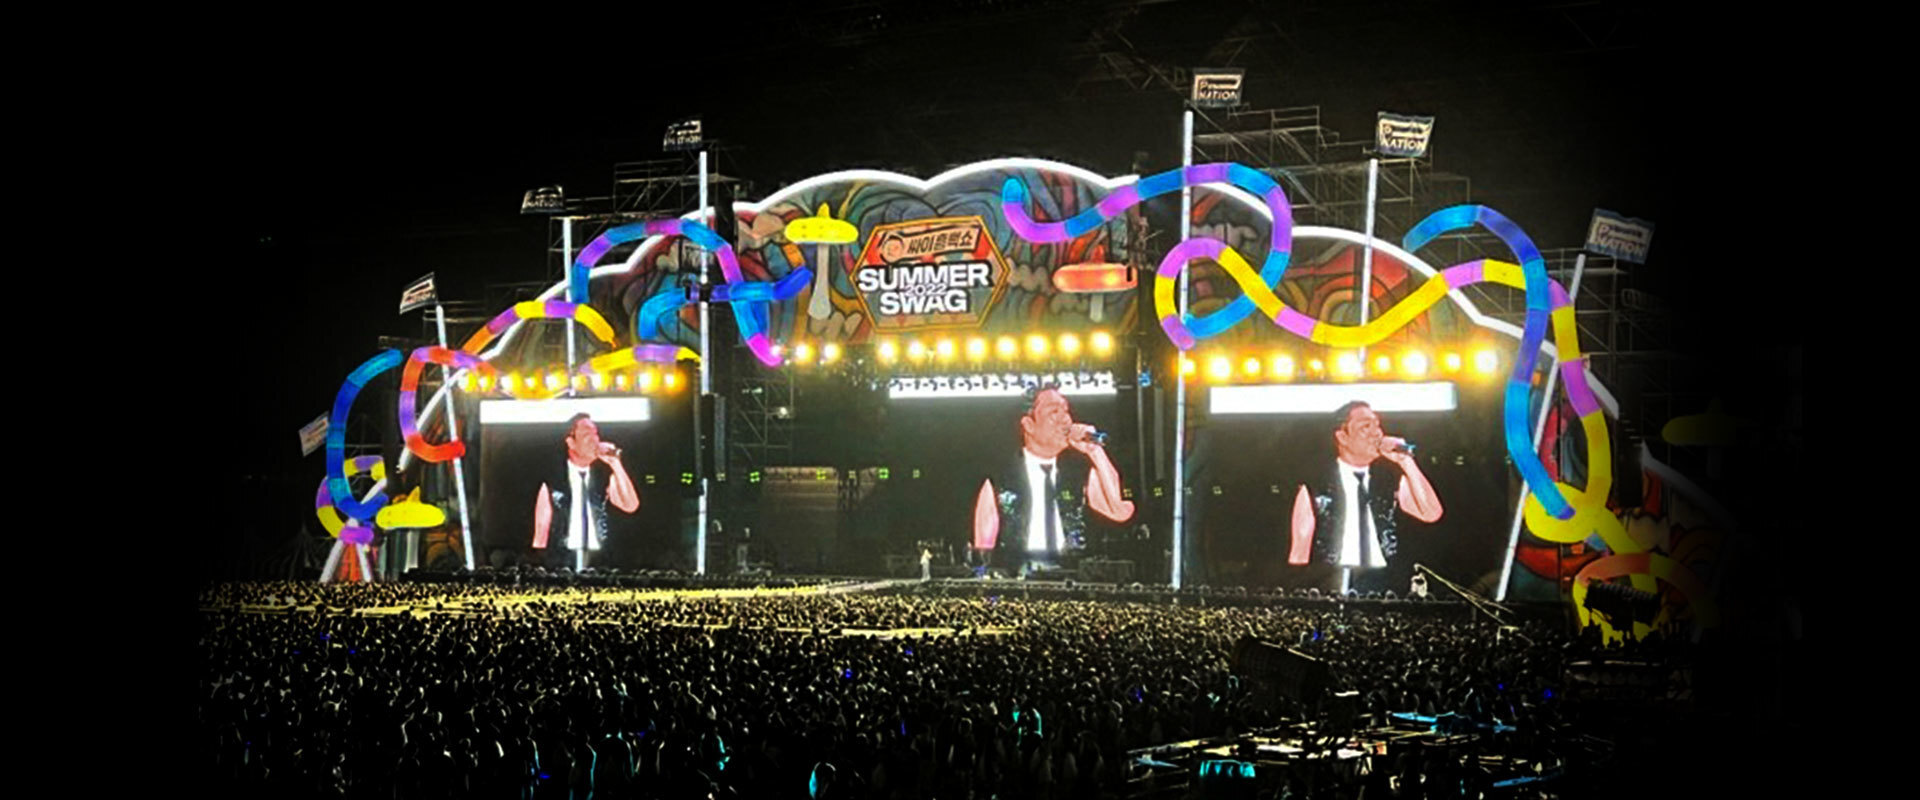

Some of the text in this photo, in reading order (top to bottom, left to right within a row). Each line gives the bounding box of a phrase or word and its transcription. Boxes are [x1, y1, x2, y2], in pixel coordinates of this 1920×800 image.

[1199, 90, 1238, 100] NATION
[1381, 137, 1426, 151] NATION
[1596, 235, 1645, 257] NATION
[858, 263, 990, 292] SUMMER
[903, 284, 947, 297] 2022
[879, 289, 968, 315] SWAG
